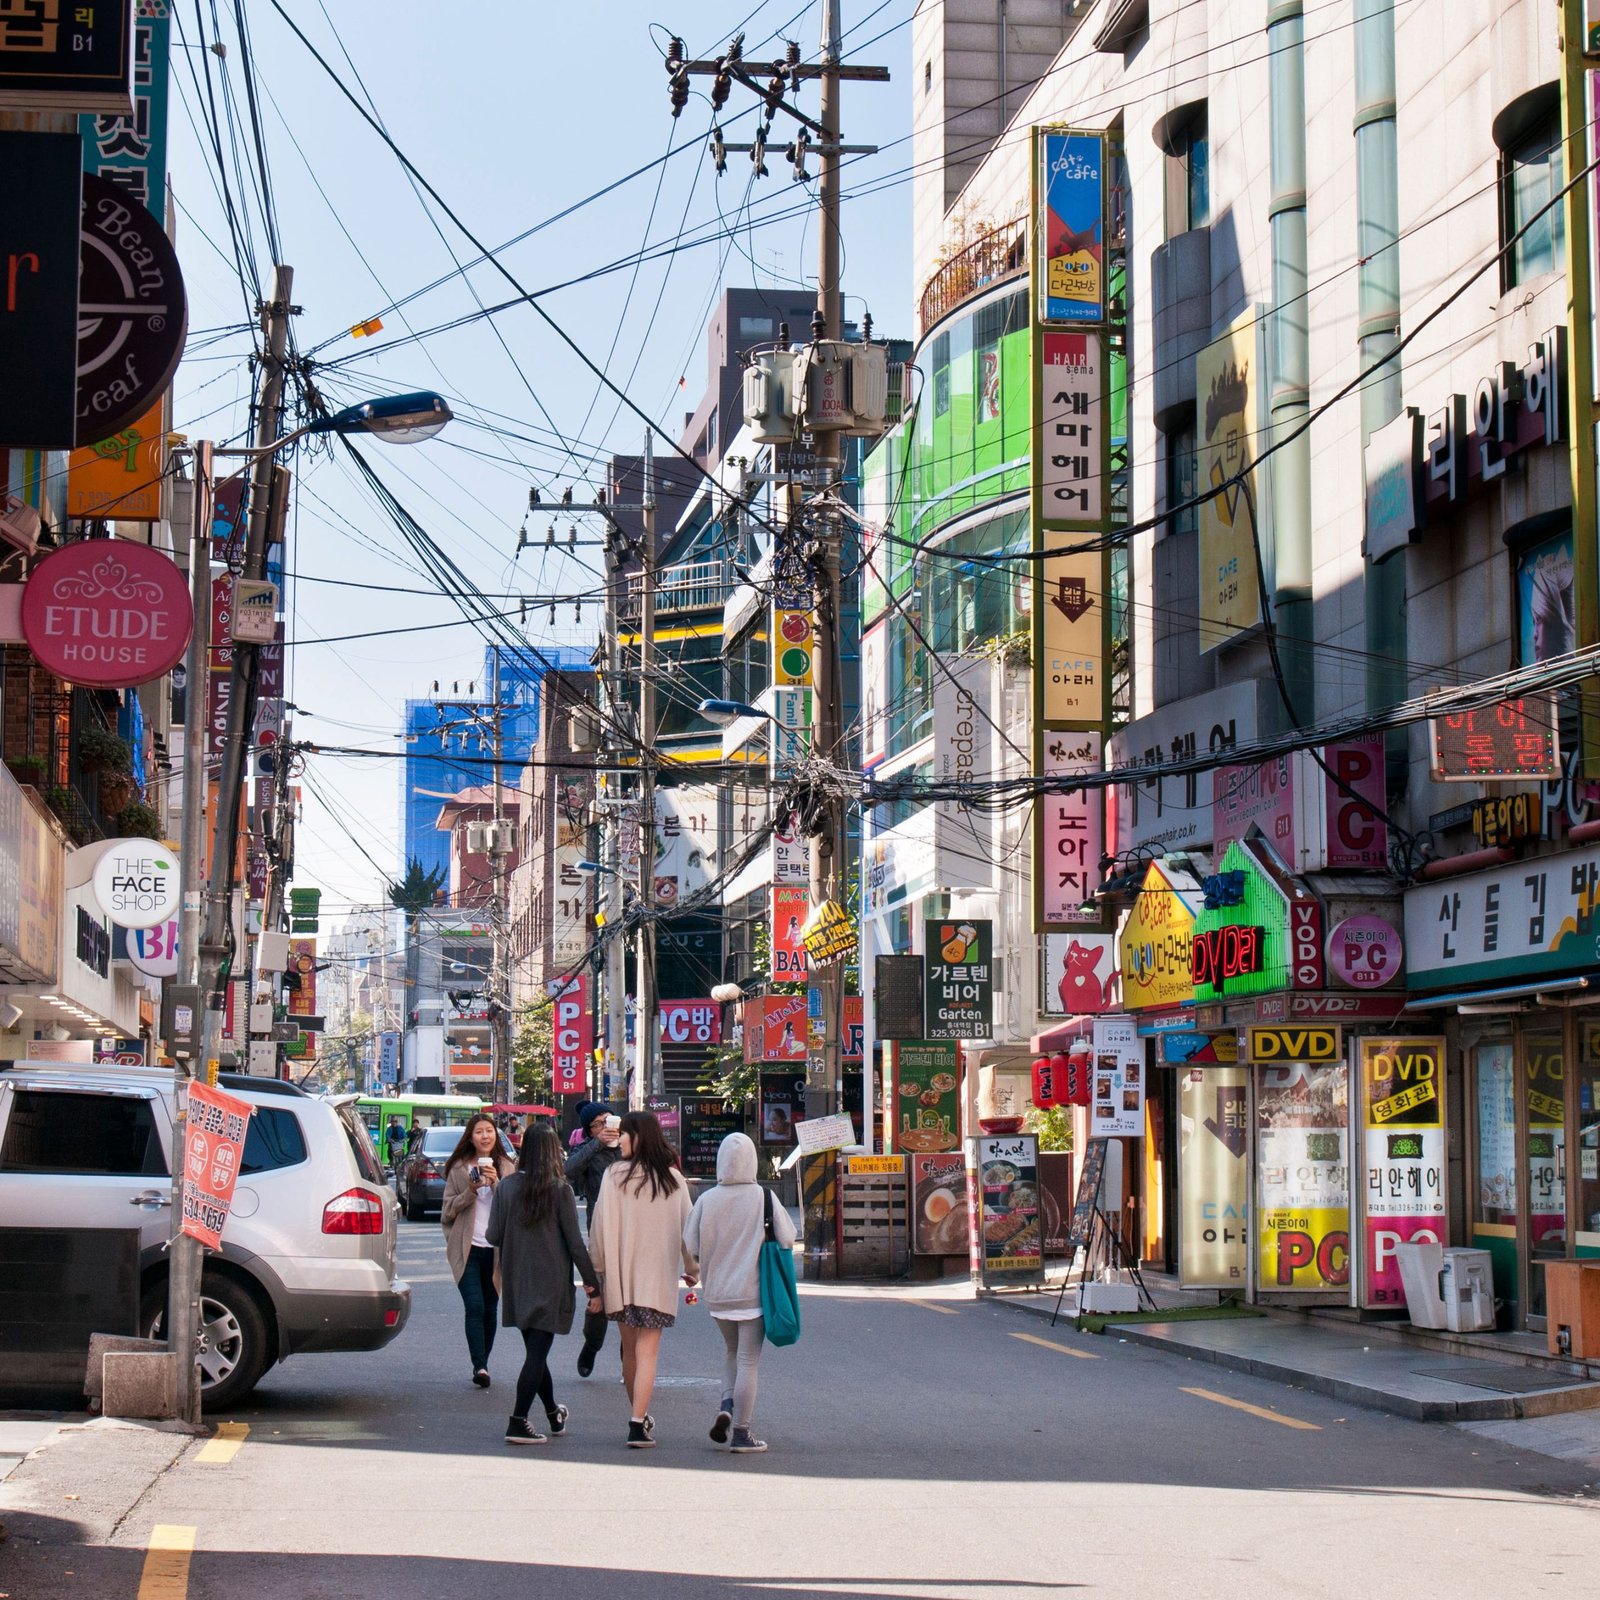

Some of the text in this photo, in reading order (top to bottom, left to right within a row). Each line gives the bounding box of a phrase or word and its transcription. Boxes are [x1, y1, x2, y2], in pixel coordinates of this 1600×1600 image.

[72, 34, 93, 52] B1
[1051, 154, 1076, 172] cat
[95, 198, 165, 298] Bean
[1051, 278, 1096, 292] 다락방
[1053, 352, 1087, 366] HAIR
[1066, 364, 1094, 375] sema
[1052, 391, 1092, 512] 세마헤어
[1218, 557, 1239, 586] CAFE
[45, 605, 169, 641] ETUDE
[63, 644, 147, 663] HOUSE
[1053, 660, 1094, 671] CAFE
[1053, 675, 1094, 686] 아래
[1067, 698, 1079, 706] B1
[951, 688, 974, 815] crepasa
[262, 782, 271, 806] SUSHI
[1337, 750, 1375, 850] PC
[113, 858, 153, 875] THE
[112, 876, 166, 893] FACE
[112, 895, 166, 911] SHOP
[1438, 862, 1599, 959] 산들김밥
[1296, 906, 1316, 962] VOD
[1343, 931, 1389, 943] 시즌아이
[1344, 943, 1388, 970] PC
[930, 966, 988, 982] 가르텐
[1356, 973, 1369, 982] B1
[942, 985, 980, 1002] 비어
[765, 997, 807, 1028] M&K
[938, 1008, 982, 1020] Garten
[1291, 998, 1361, 1014] DVD21
[930, 1029, 973, 1038] 325.9286
[974, 1022, 990, 1037] B1
[557, 1002, 581, 1079] PC방
[1254, 1031, 1335, 1058] DVD
[769, 1050, 780, 1058] B1
[900, 1053, 956, 1067] 가르텐 비어
[1373, 1054, 1435, 1081] DVD
[563, 1081, 575, 1090] B1
[1375, 1084, 1431, 1118] 영화관
[1369, 1166, 1441, 1198] 리안헤어
[1267, 1218, 1309, 1230] 시즌아이
[1276, 1231, 1349, 1286] PC
